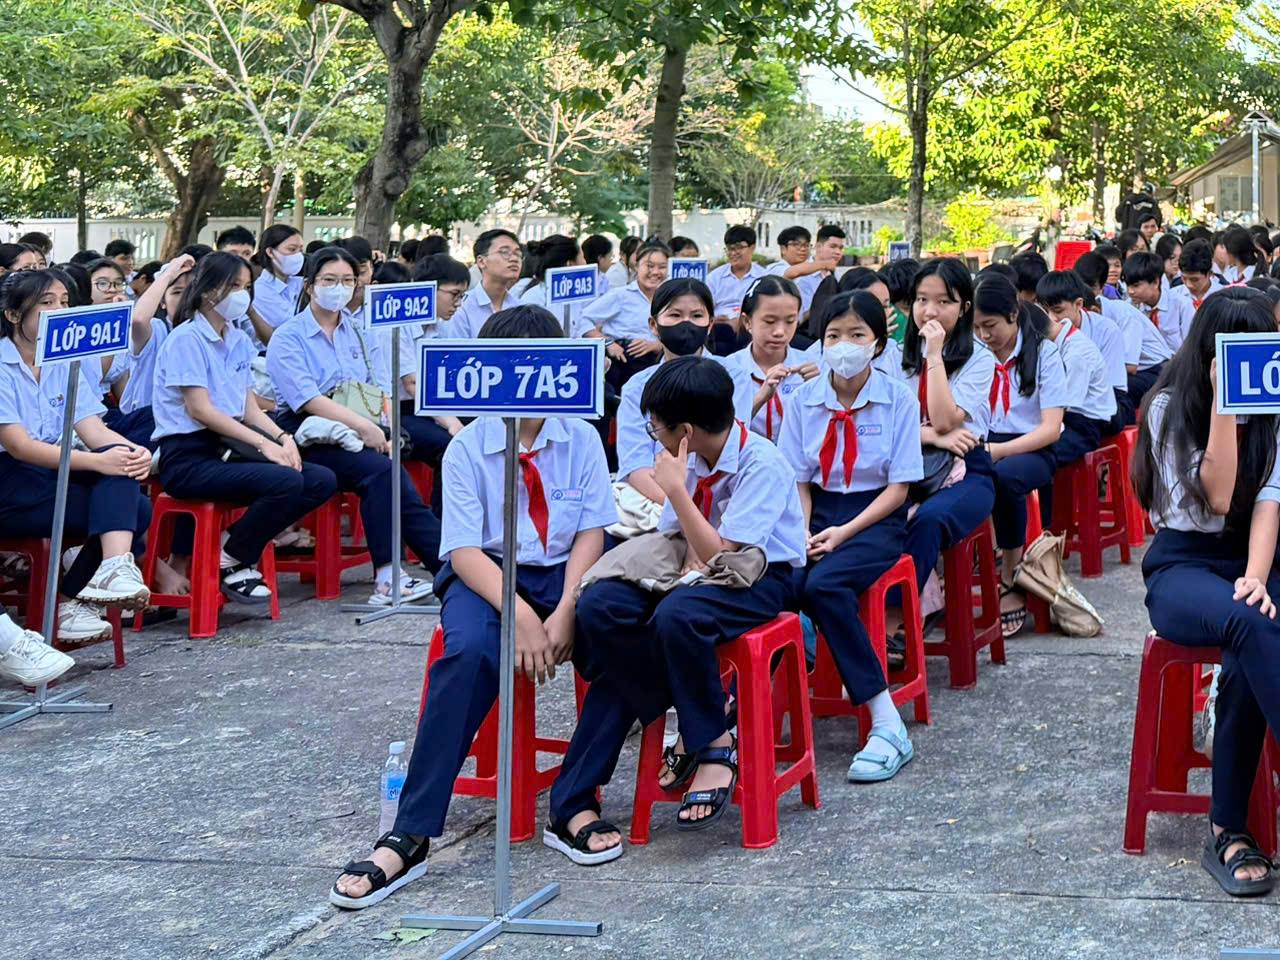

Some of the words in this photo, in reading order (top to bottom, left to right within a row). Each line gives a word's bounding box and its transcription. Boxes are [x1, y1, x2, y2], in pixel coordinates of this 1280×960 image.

[553, 275, 573, 298] LỚP
[574, 276, 592, 295] 9A3
[375, 294, 401, 320] LỚP
[404, 296, 429, 317] 9A2
[50, 320, 87, 353] LỚP
[90, 320, 121, 347] 9A1
[437, 356, 503, 400] LỚP
[514, 364, 579, 399] 7A5
